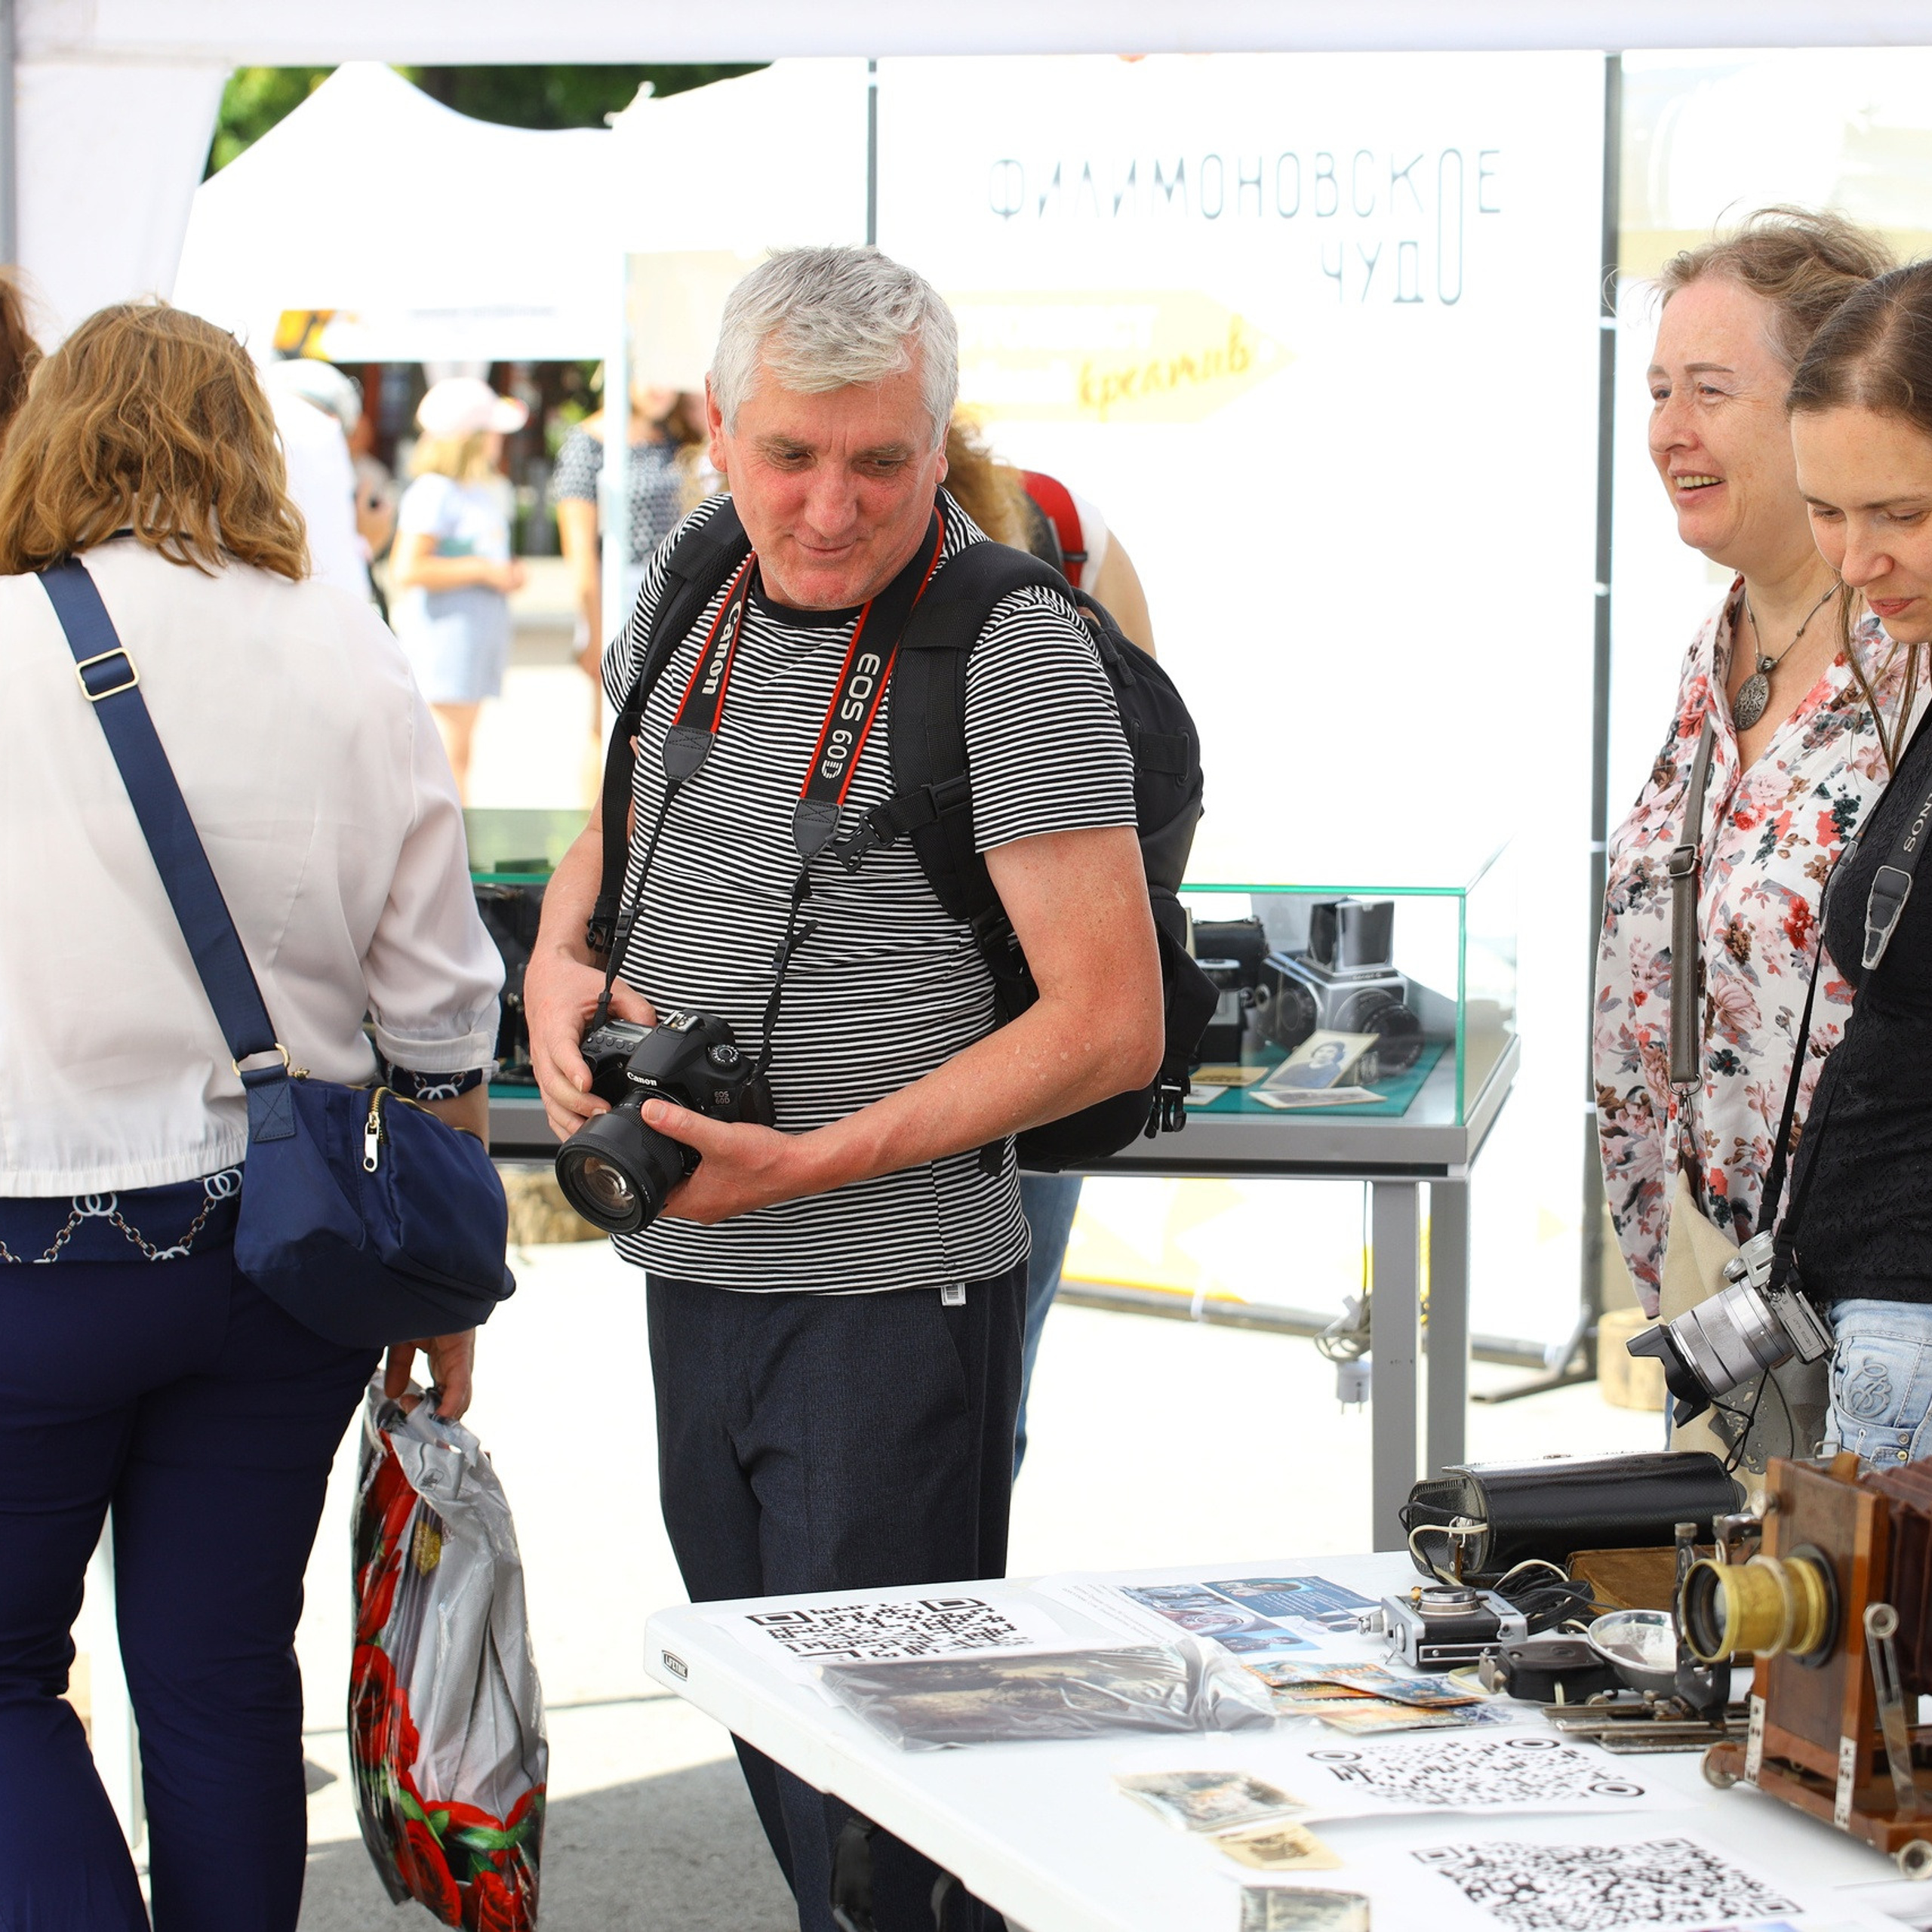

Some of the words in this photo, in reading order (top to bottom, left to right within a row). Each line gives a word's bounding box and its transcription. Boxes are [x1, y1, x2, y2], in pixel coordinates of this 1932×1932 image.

[989, 149, 1501, 230] ФИЛИМОНОВСКОЕ
[1321, 241, 1463, 305] ЧУДО
[702, 601, 742, 695] Canon
[841, 653, 881, 721] EOS
[821, 730, 852, 779] 60D
[1903, 792, 1932, 852] SON
[626, 1072, 657, 1086] Canon
